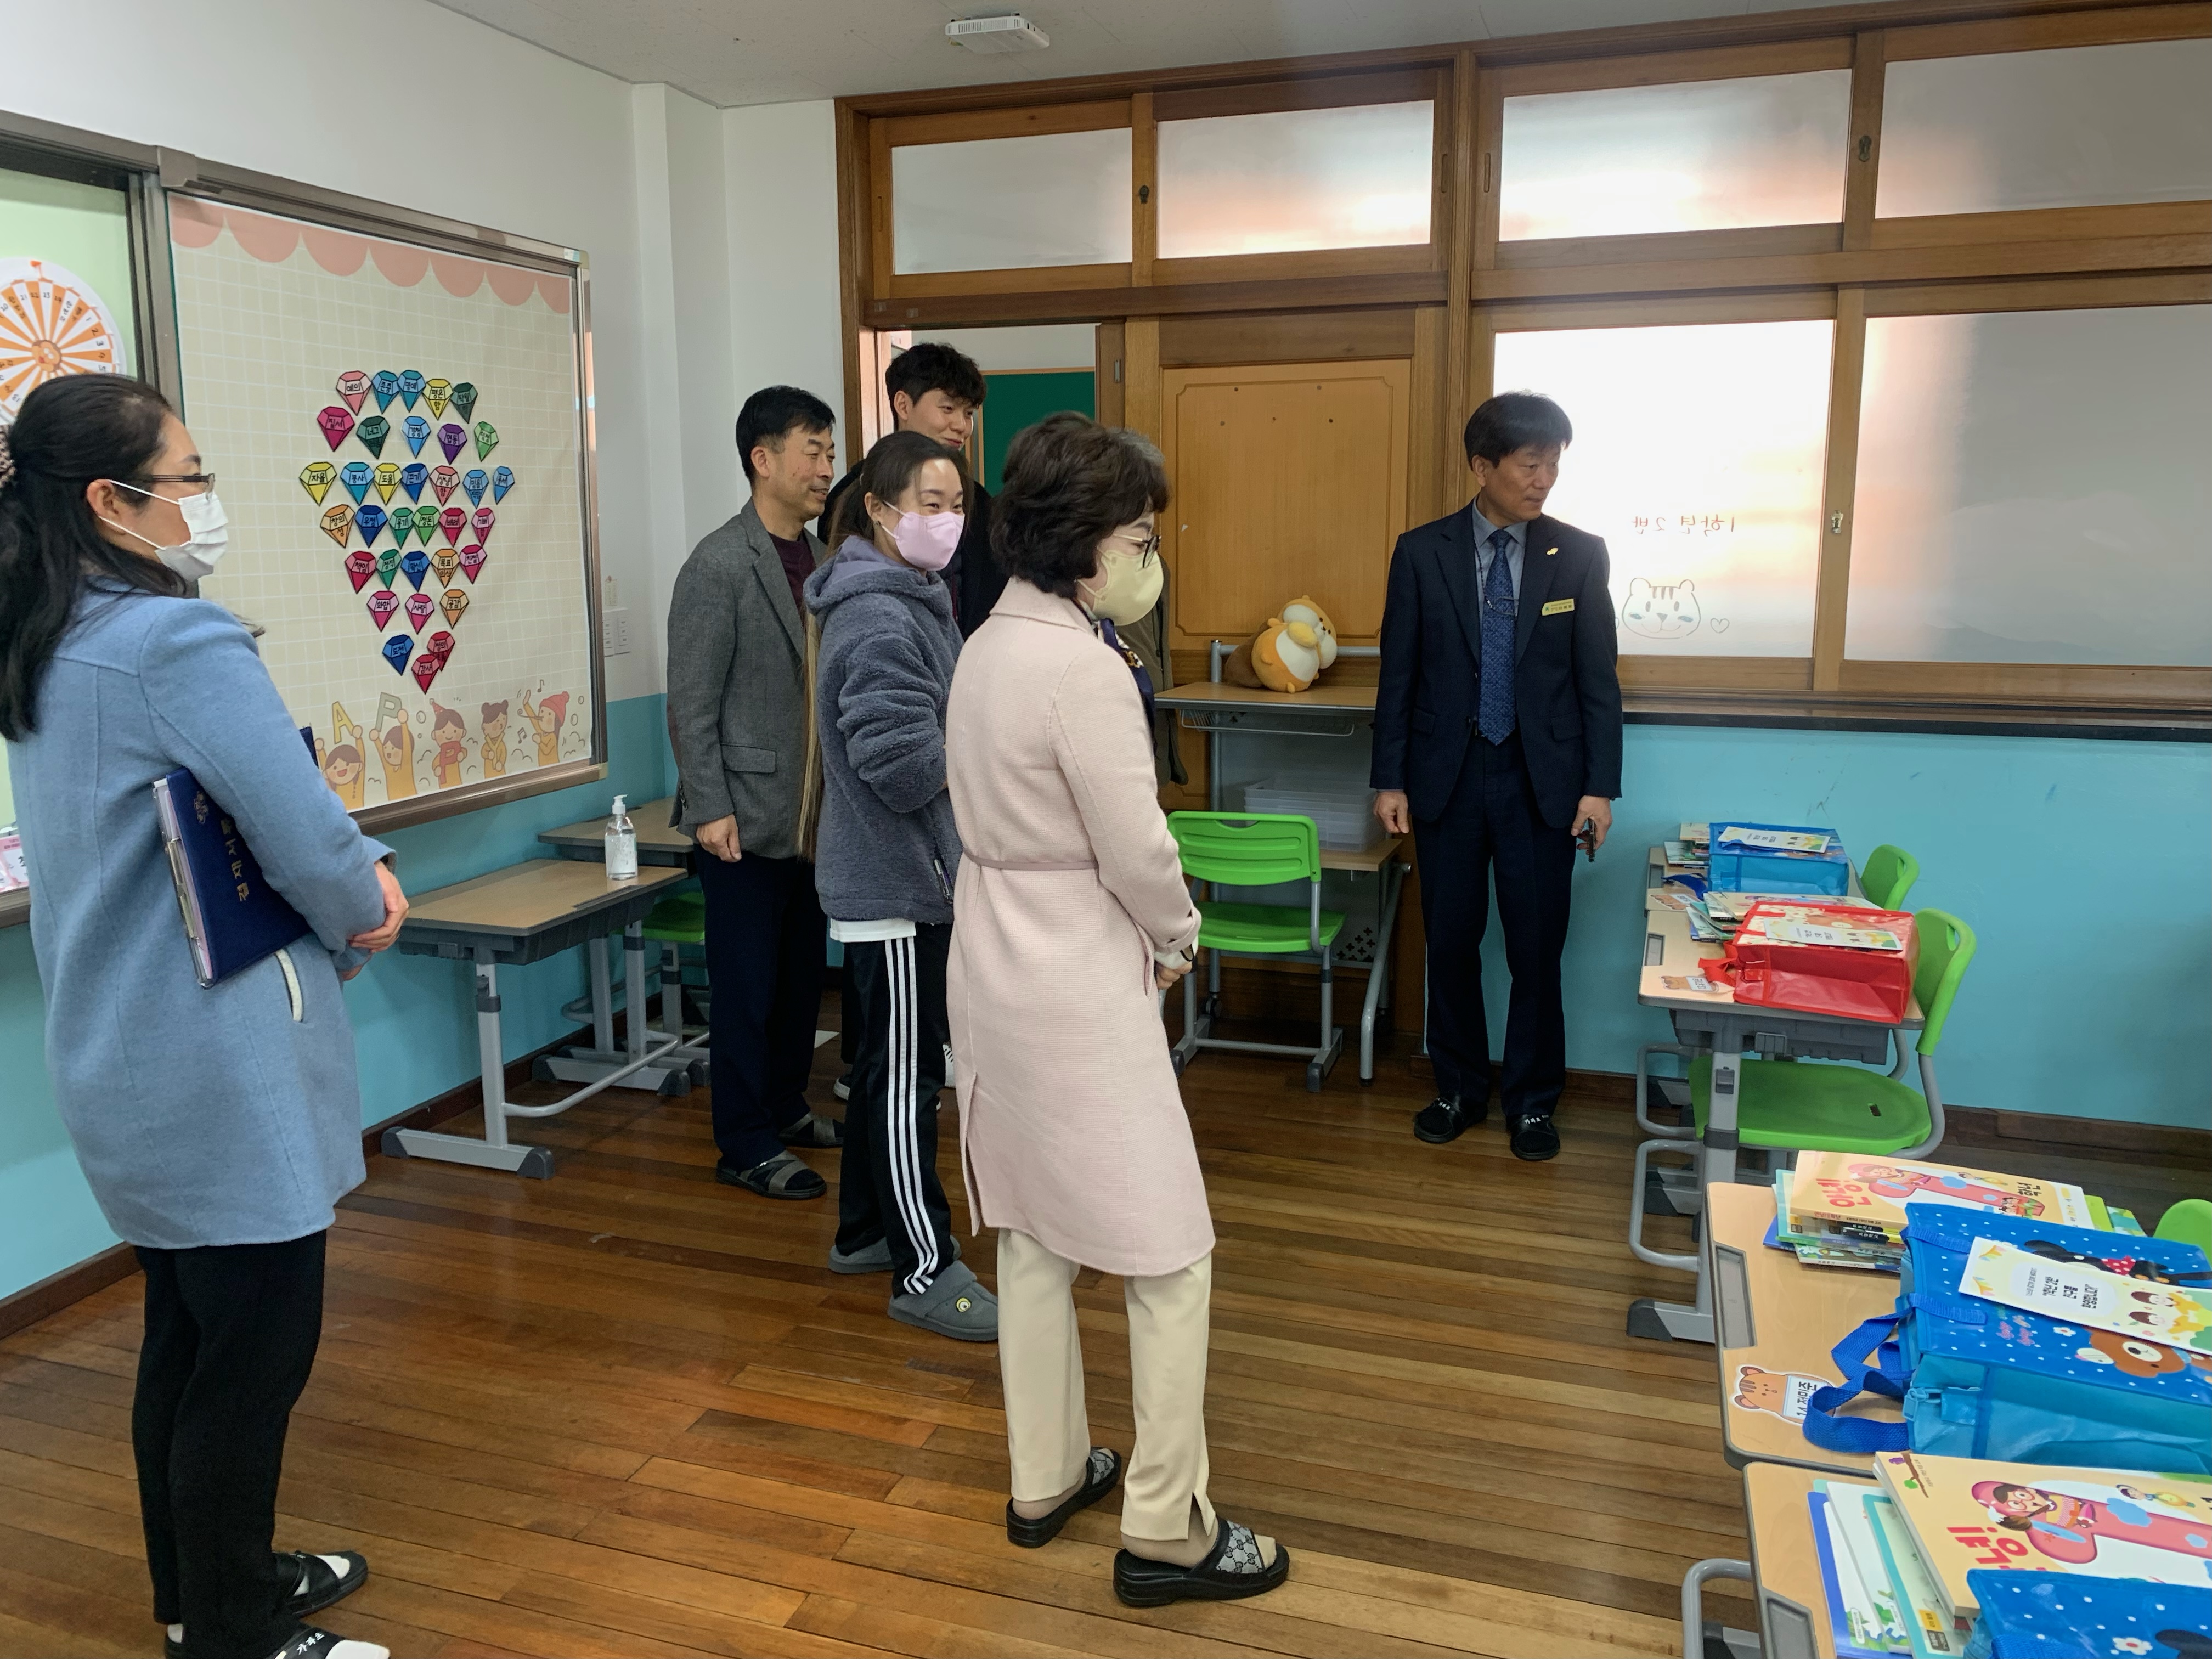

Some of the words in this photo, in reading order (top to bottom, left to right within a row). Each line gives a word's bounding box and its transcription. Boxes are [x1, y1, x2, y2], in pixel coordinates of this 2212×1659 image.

[347, 383, 360, 392] 예의
[431, 388, 443, 399] 평온
[367, 426, 379, 436] 너그
[446, 434, 458, 445] 협동
[311, 472, 325, 483] 자율
[351, 474, 364, 483] 봉사
[382, 475, 393, 484] 도움
[438, 475, 451, 487] 상냥
[440, 488, 447, 497] 함
[331, 514, 345, 527] 창의
[364, 517, 376, 527] 우정
[397, 518, 407, 529] 용기
[337, 527, 344, 537] 성
[441, 557, 451, 567] 목표
[413, 603, 426, 613] 사랑
[420, 664, 432, 674] 감사
[1815, 1178, 1872, 1207] 안녕!
